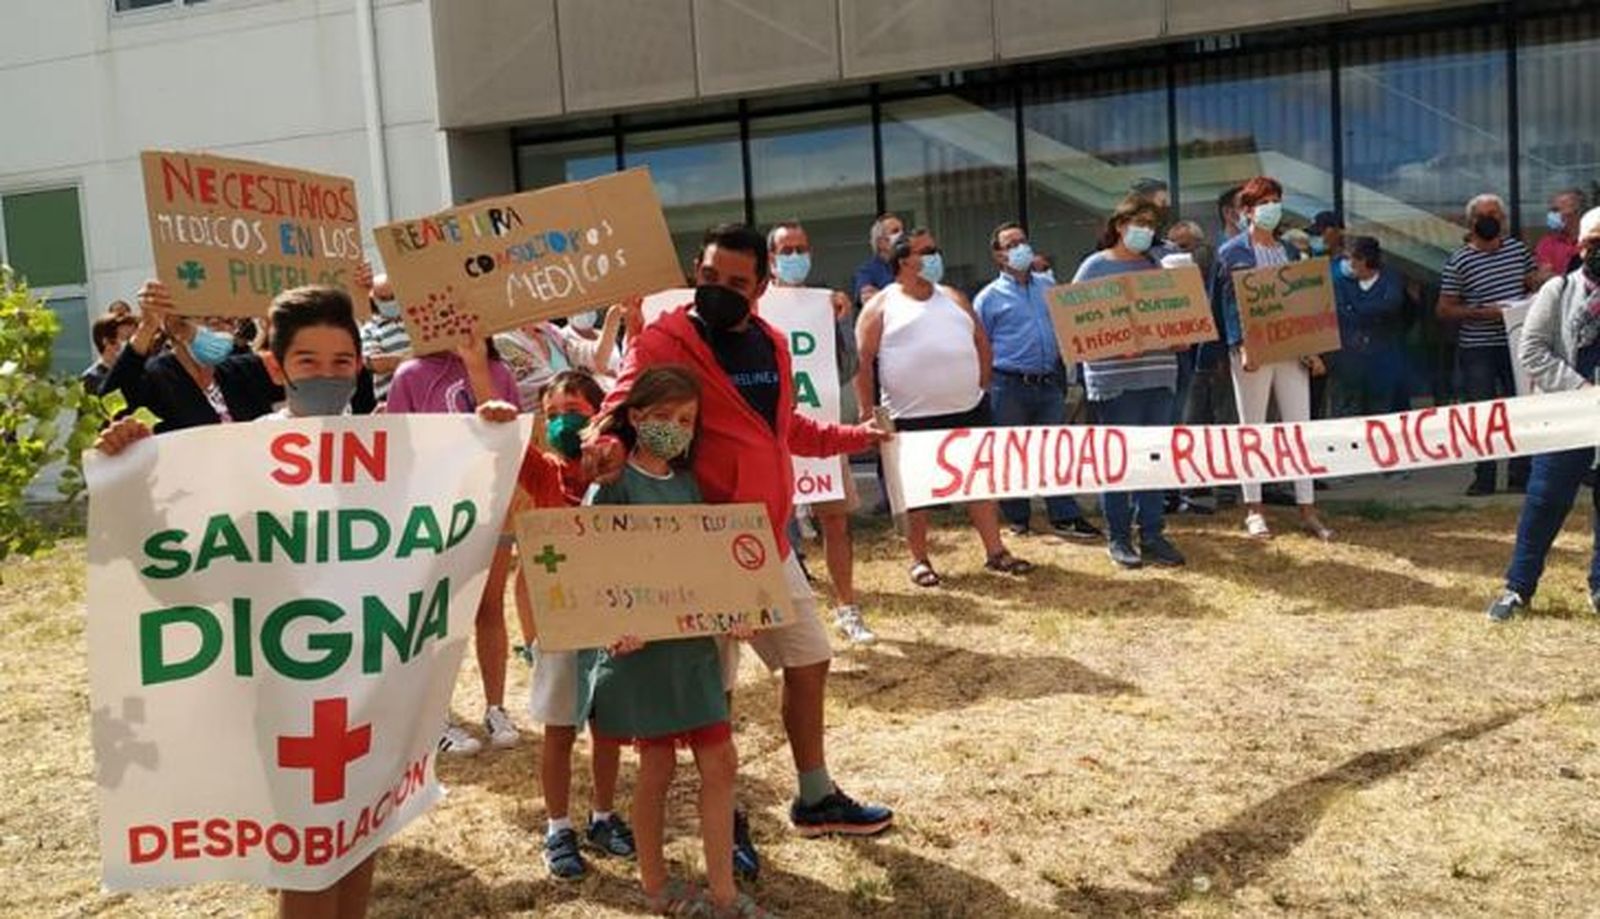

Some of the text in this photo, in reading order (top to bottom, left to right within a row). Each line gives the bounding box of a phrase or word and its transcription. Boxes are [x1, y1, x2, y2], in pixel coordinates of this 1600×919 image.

[161, 157, 358, 222] NECESITAMOS
[278, 220, 314, 258] EN
[319, 226, 361, 260] LOS
[269, 430, 388, 485] SIN
[931, 402, 1517, 498] SANIDAD RURAL DIGNA
[140, 499, 478, 580] SANIDAD
[139, 577, 450, 686] DIGNA
